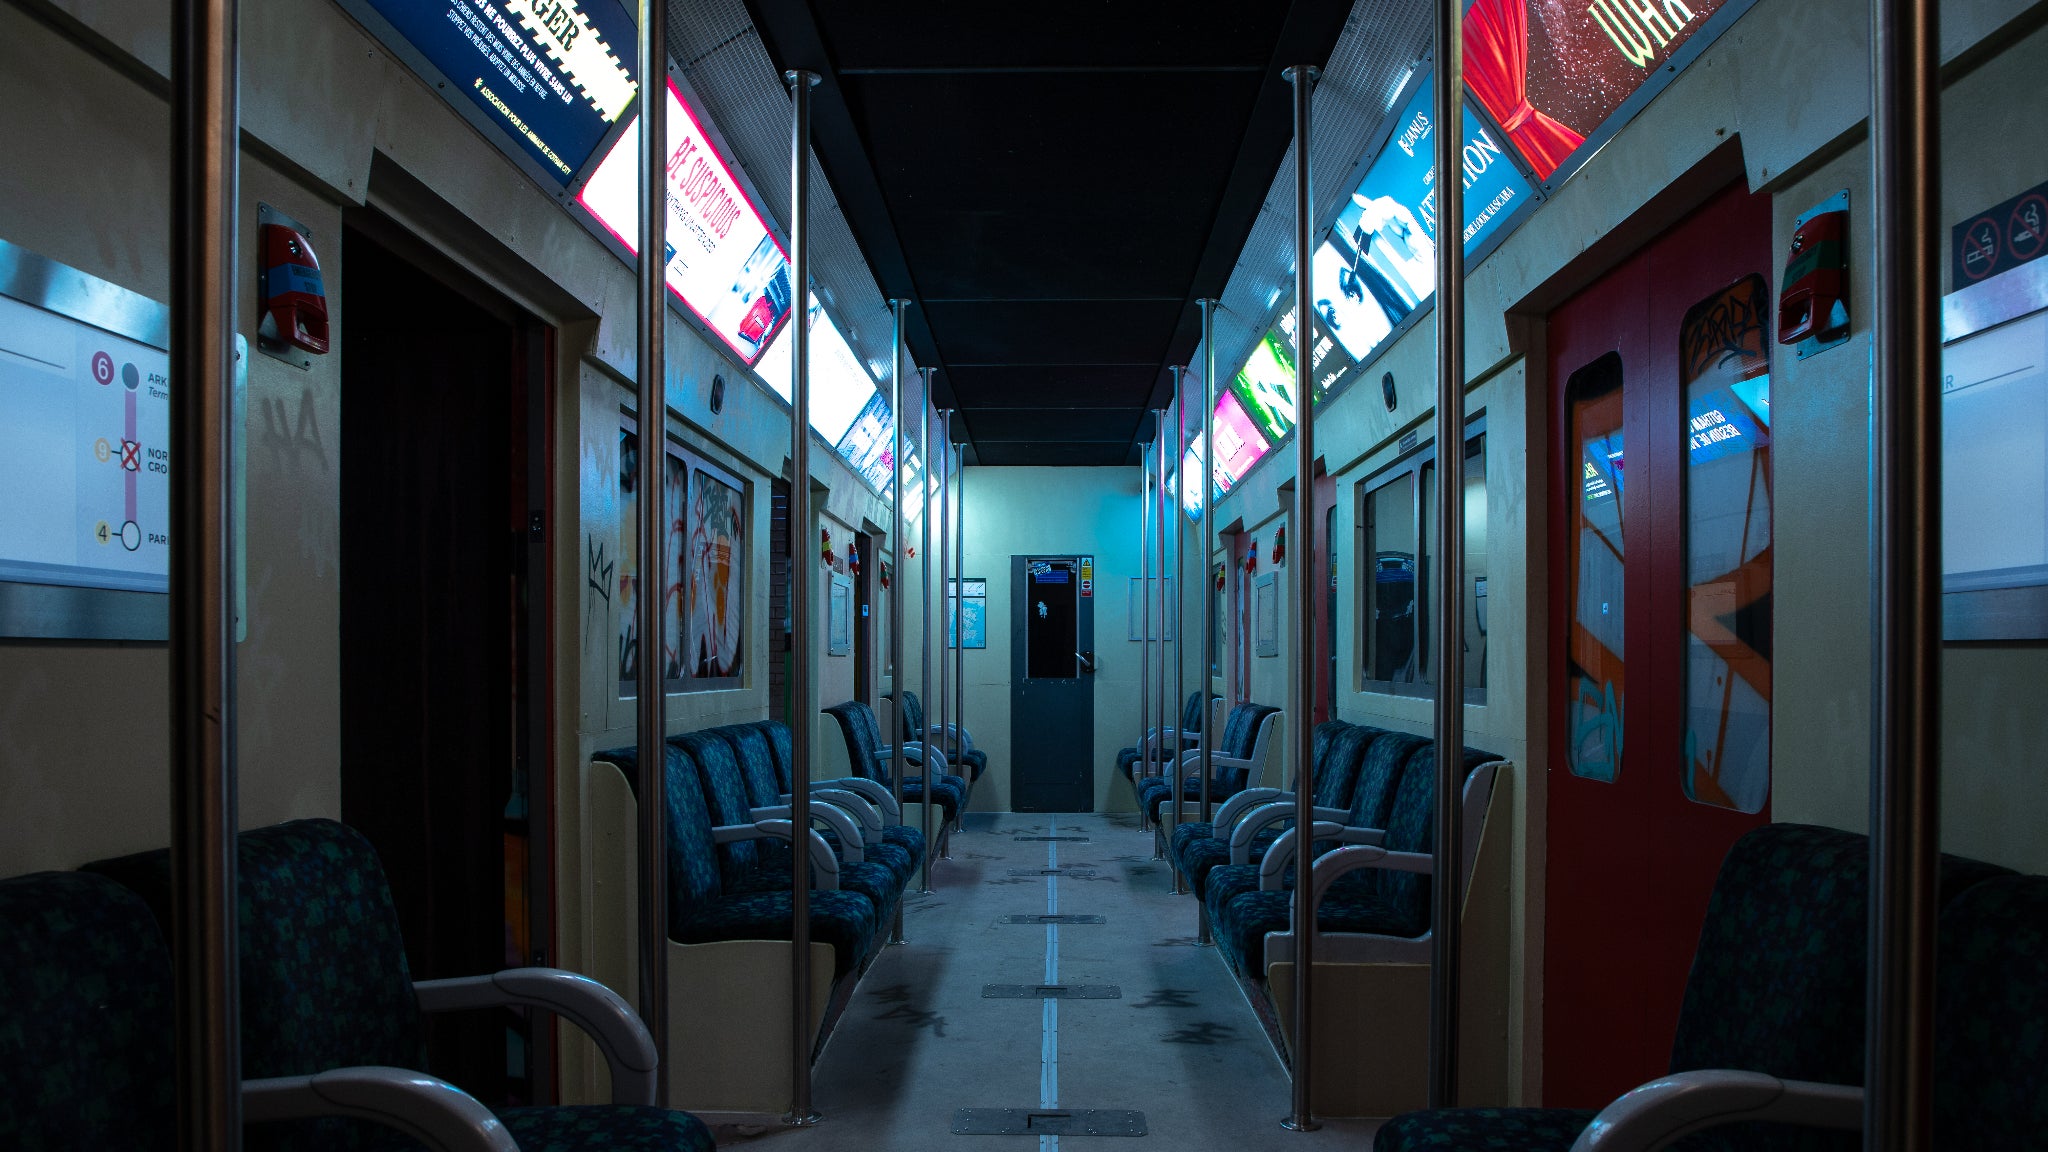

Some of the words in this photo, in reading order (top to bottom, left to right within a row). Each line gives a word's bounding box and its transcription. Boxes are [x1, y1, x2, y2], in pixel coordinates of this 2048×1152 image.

[446, 8, 467, 32] STOPPEZ
[463, 25, 475, 39] VOS
[488, 52, 507, 73] ADOPTEZ
[469, 14, 490, 36] RESTENT
[485, 31, 496, 44] DES
[514, 0, 580, 52] GER
[493, 13, 523, 50] POURREZ
[520, 43, 537, 65] PLUS
[534, 58, 552, 82] VIVRE
[548, 75, 566, 96] SANS
[561, 89, 574, 105] LUI
[480, 86, 510, 117] ASSOCIATION
[507, 111, 522, 128] POUR
[519, 122, 529, 135] LES
[1405, 111, 1430, 147] JANUS
[666, 136, 697, 180] BE
[666, 190, 689, 222] NYTHING
[680, 156, 741, 240] SUSPICIOUS
[1472, 210, 1491, 231] LOOK
[1485, 186, 1516, 216] MASCARA
[97, 357, 109, 380] 6
[98, 525, 108, 542] 4
